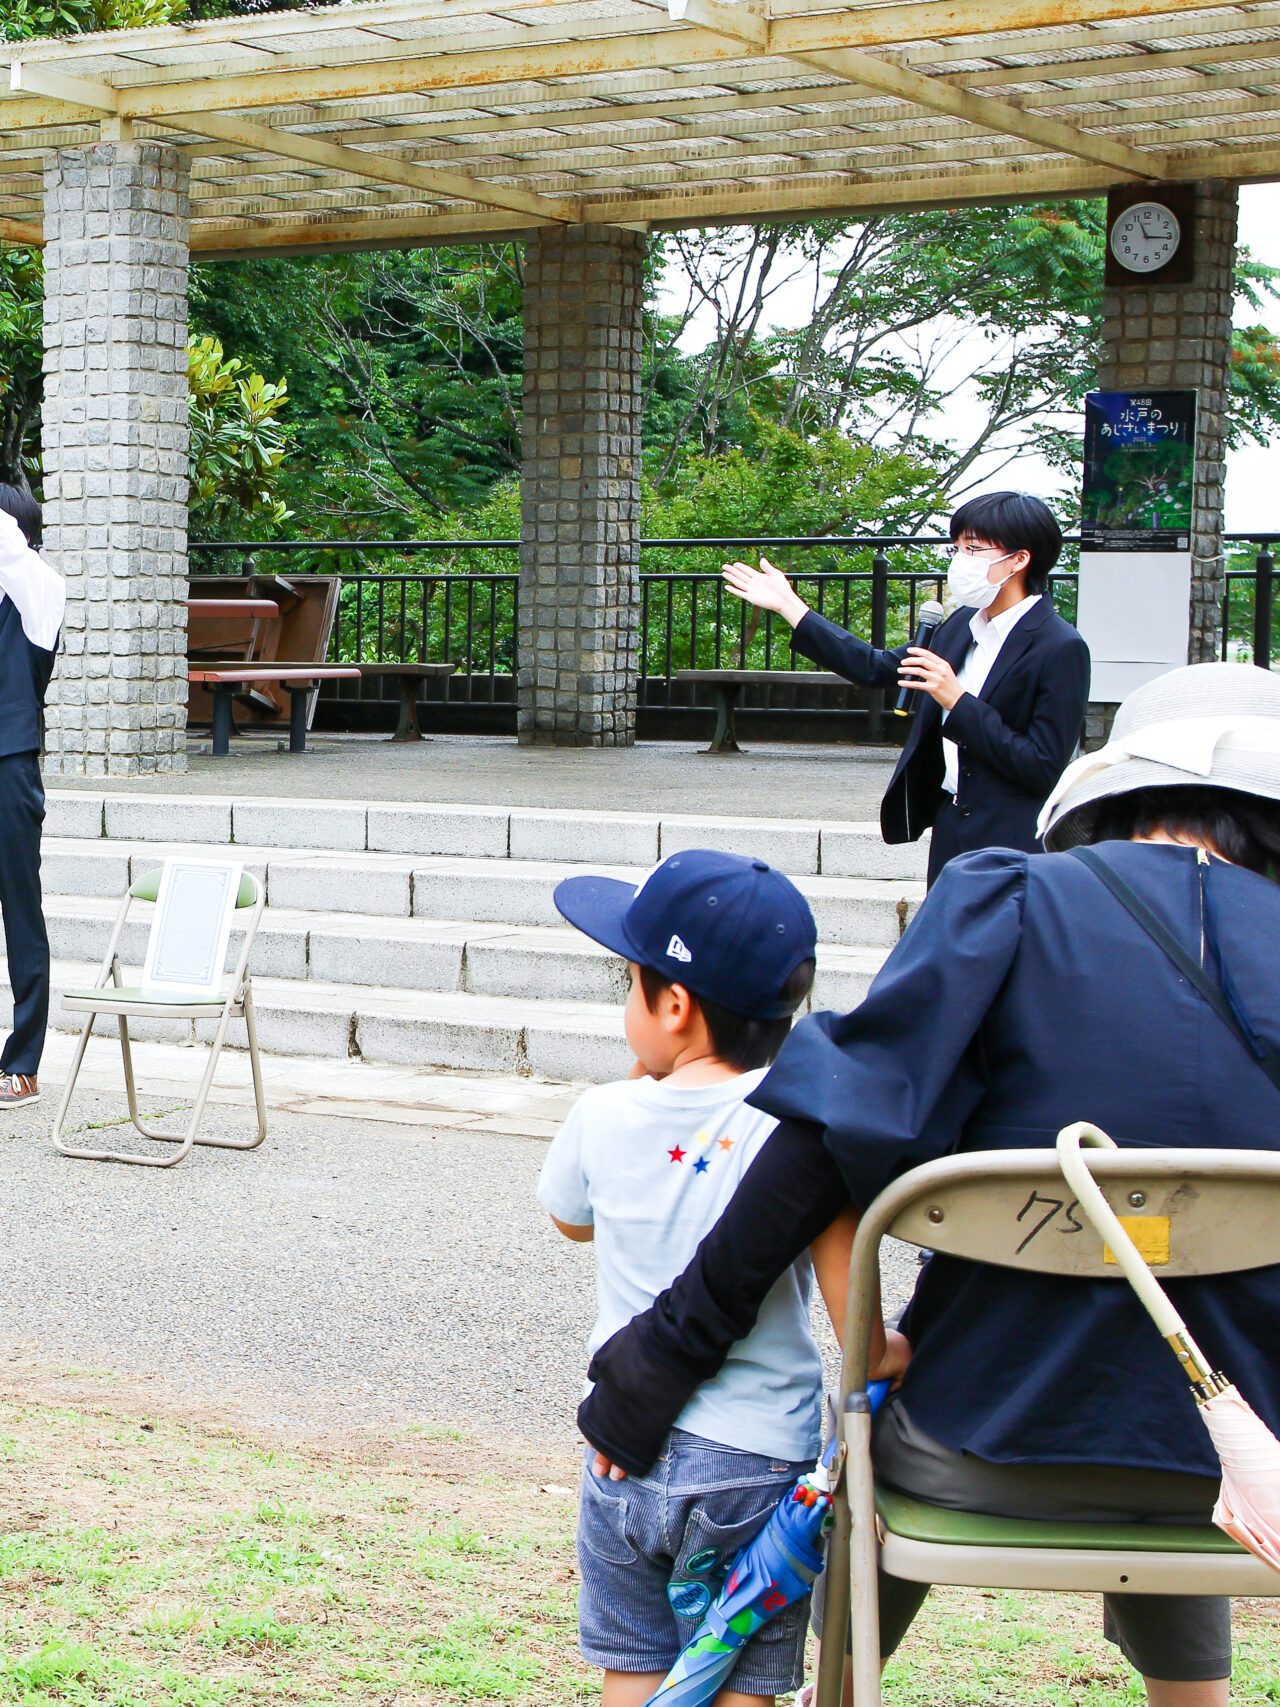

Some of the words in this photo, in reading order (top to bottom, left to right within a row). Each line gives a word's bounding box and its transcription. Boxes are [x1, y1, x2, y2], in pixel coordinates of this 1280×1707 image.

[1144, 212, 1152, 220] 12
[1166, 232, 1172, 240] 3
[1120, 407, 1163, 422] 水戸の
[1101, 421, 1179, 437] あじさいまつり
